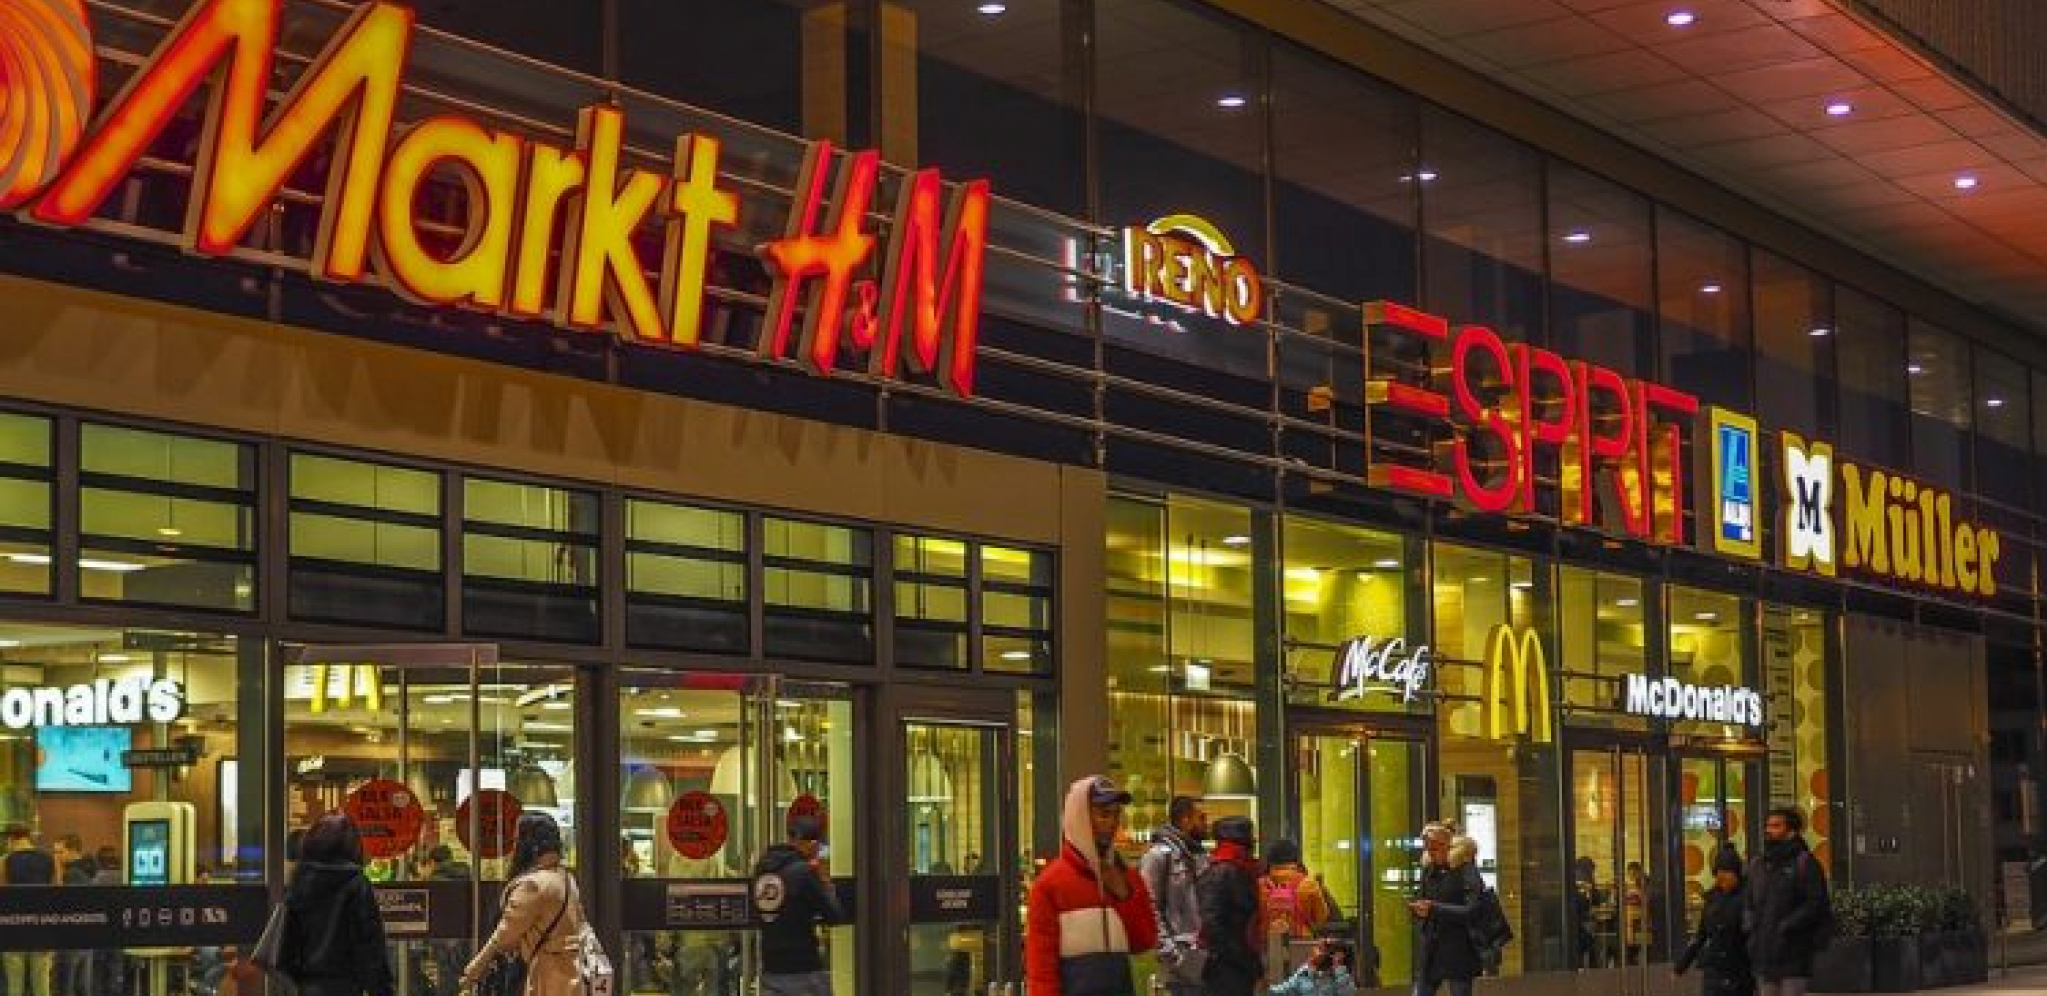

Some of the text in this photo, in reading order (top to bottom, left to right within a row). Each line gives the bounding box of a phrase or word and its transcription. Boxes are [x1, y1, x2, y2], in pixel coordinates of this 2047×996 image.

[29, 0, 740, 347] Markt
[757, 139, 990, 399] H&M
[1123, 222, 1264, 326] RENO
[1364, 299, 1700, 545] ESPRIT
[1796, 462, 2000, 596] M Müller
[1627, 673, 1763, 727] McDonald's
